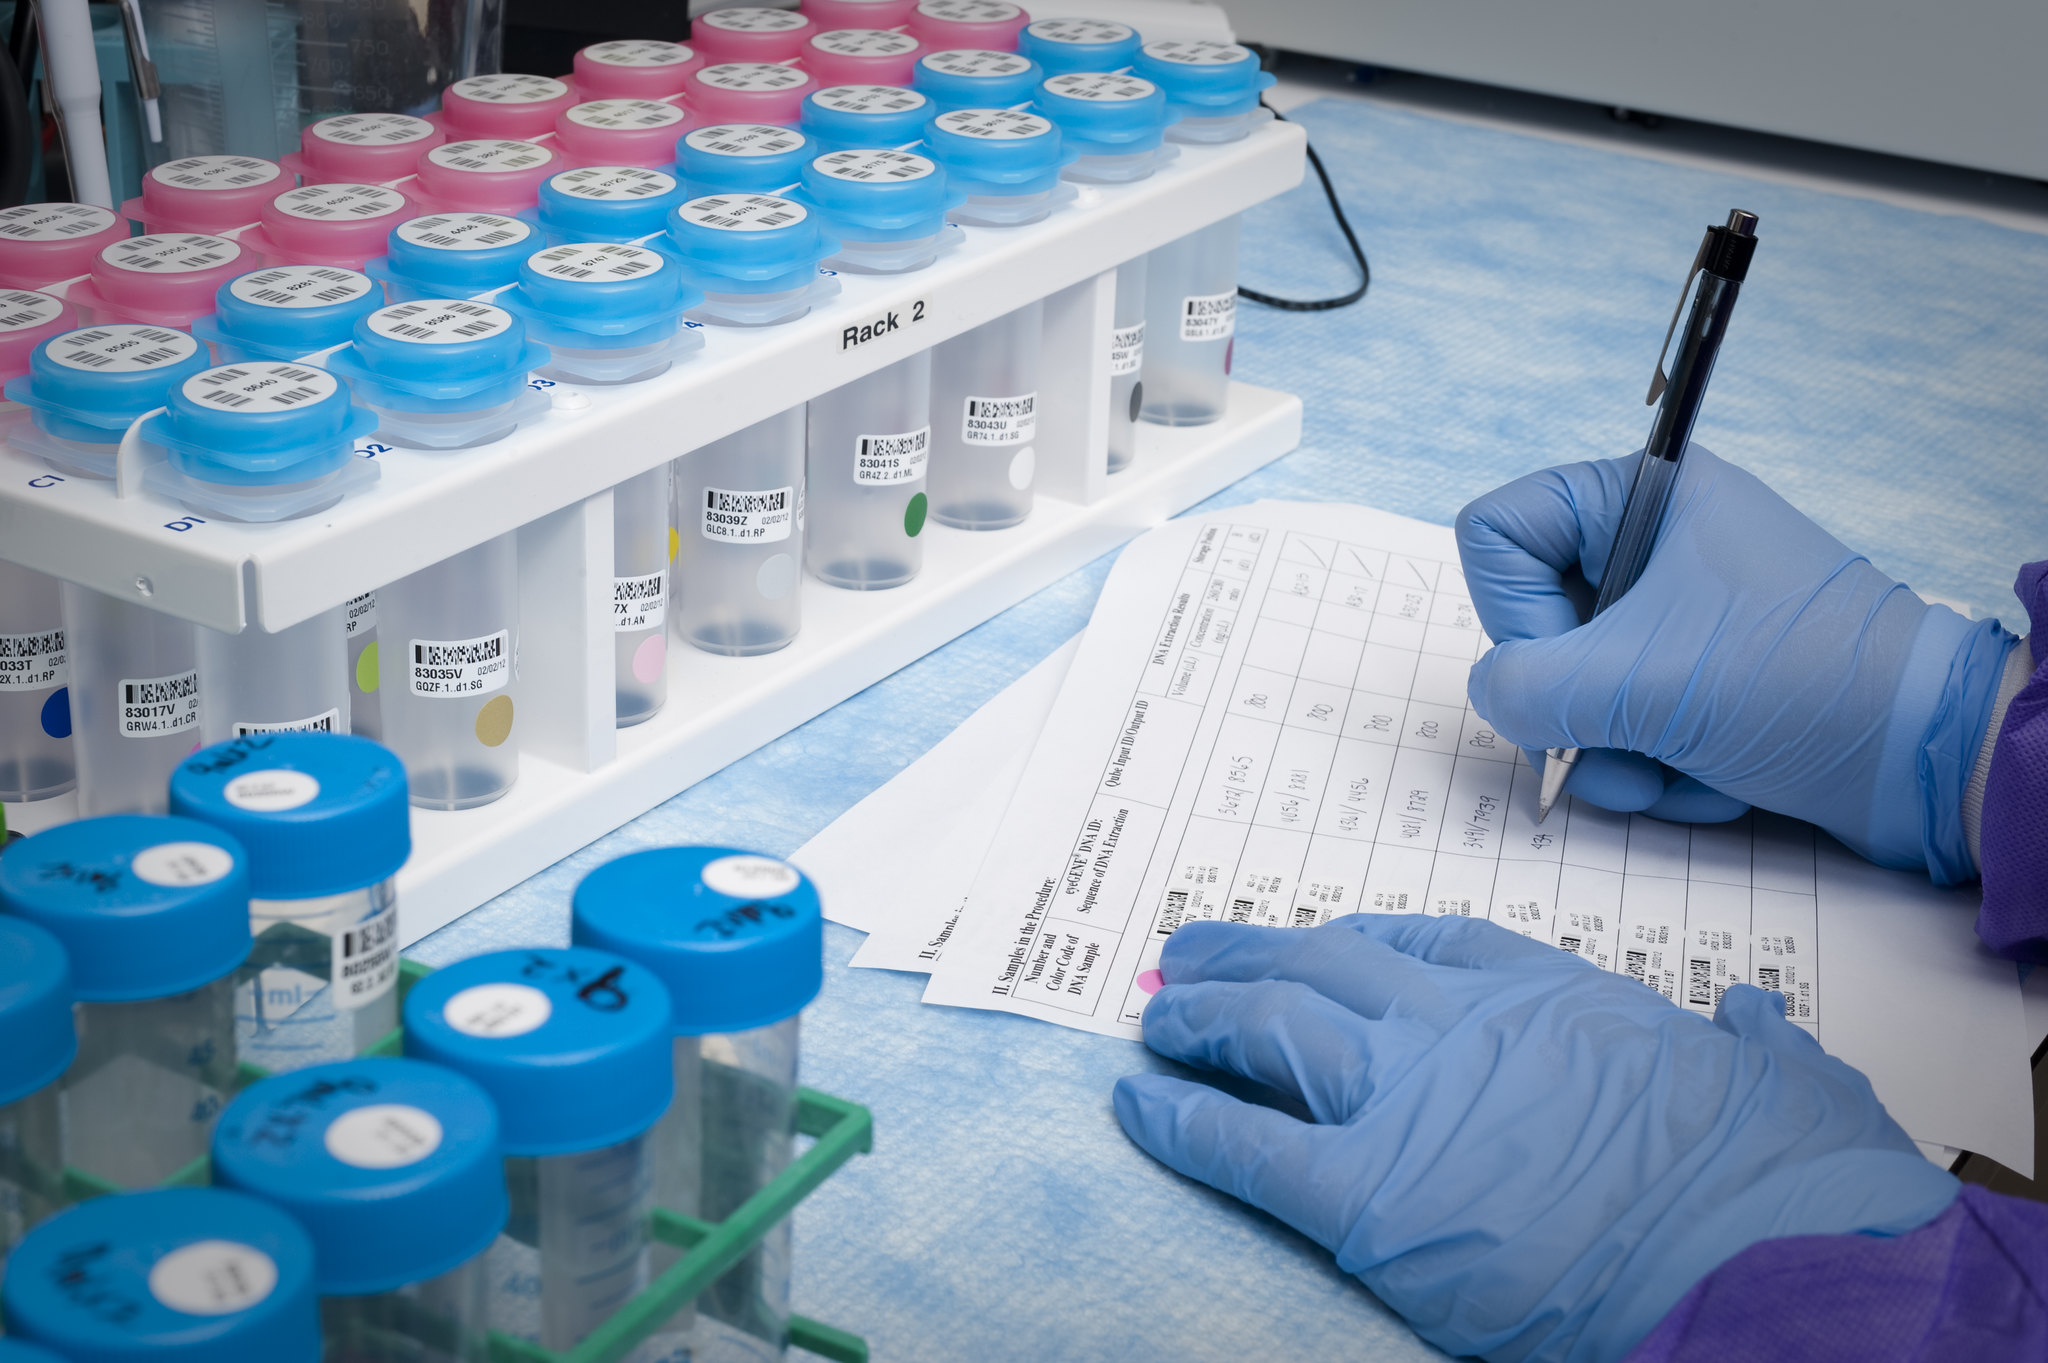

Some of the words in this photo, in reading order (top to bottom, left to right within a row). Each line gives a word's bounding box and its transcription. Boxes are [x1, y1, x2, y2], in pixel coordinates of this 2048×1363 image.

[351, 39, 389, 56] 750
[203, 166, 231, 177] 4361
[600, 177, 627, 187] 8729
[33, 214, 63, 226] 4056
[450, 224, 478, 235] 4456
[581, 255, 608, 267] 8747
[286, 279, 318, 291] 8281
[425, 314, 456, 326] 8586
[843, 312, 899, 350] Rack
[912, 301, 925, 322] 2
[105, 340, 140, 354] 8565
[243, 379, 278, 393] 8640
[967, 419, 1008, 430] 83043U
[860, 459, 900, 468] 83041S
[28, 475, 65, 488] C1
[163, 516, 206, 533] D1
[706, 511, 748, 526] 83039Z
[761, 512, 789, 525] 02/02/12
[1172, 592, 1191, 615] Results
[1159, 613, 1183, 648] Extraction
[1189, 607, 1216, 648] Concentration
[1152, 647, 1170, 666] DNA
[415, 667, 462, 680] 83035V
[477, 658, 506, 676] 02/02/12
[1171, 671, 1192, 697] Volume
[125, 702, 176, 719] 83017V
[1134, 699, 1149, 712] ID
[1112, 745, 1132, 768] Input
[1104, 766, 1124, 788] Qube
[1086, 817, 1104, 831] ID:
[1102, 807, 1129, 849] Extraction
[1078, 828, 1095, 853] DNA
[1096, 847, 1114, 869] DNA
[1092, 863, 1103, 879] of
[1025, 877, 1057, 922] Procedure:
[1076, 878, 1101, 914] Sequence
[1020, 920, 1037, 936] the
[1013, 933, 1031, 947] in
[919, 949, 939, 960] II.
[1024, 951, 1046, 984] Number
[1043, 933, 1057, 951] and
[1045, 967, 1061, 992] Color
[1055, 945, 1074, 967] Code
[1066, 934, 1080, 946] of
[1076, 942, 1101, 974] Sample
[998, 945, 1025, 984] Samples
[992, 982, 1010, 996] II.
[1067, 973, 1088, 996] DNA
[1125, 1012, 1140, 1020] 1.
